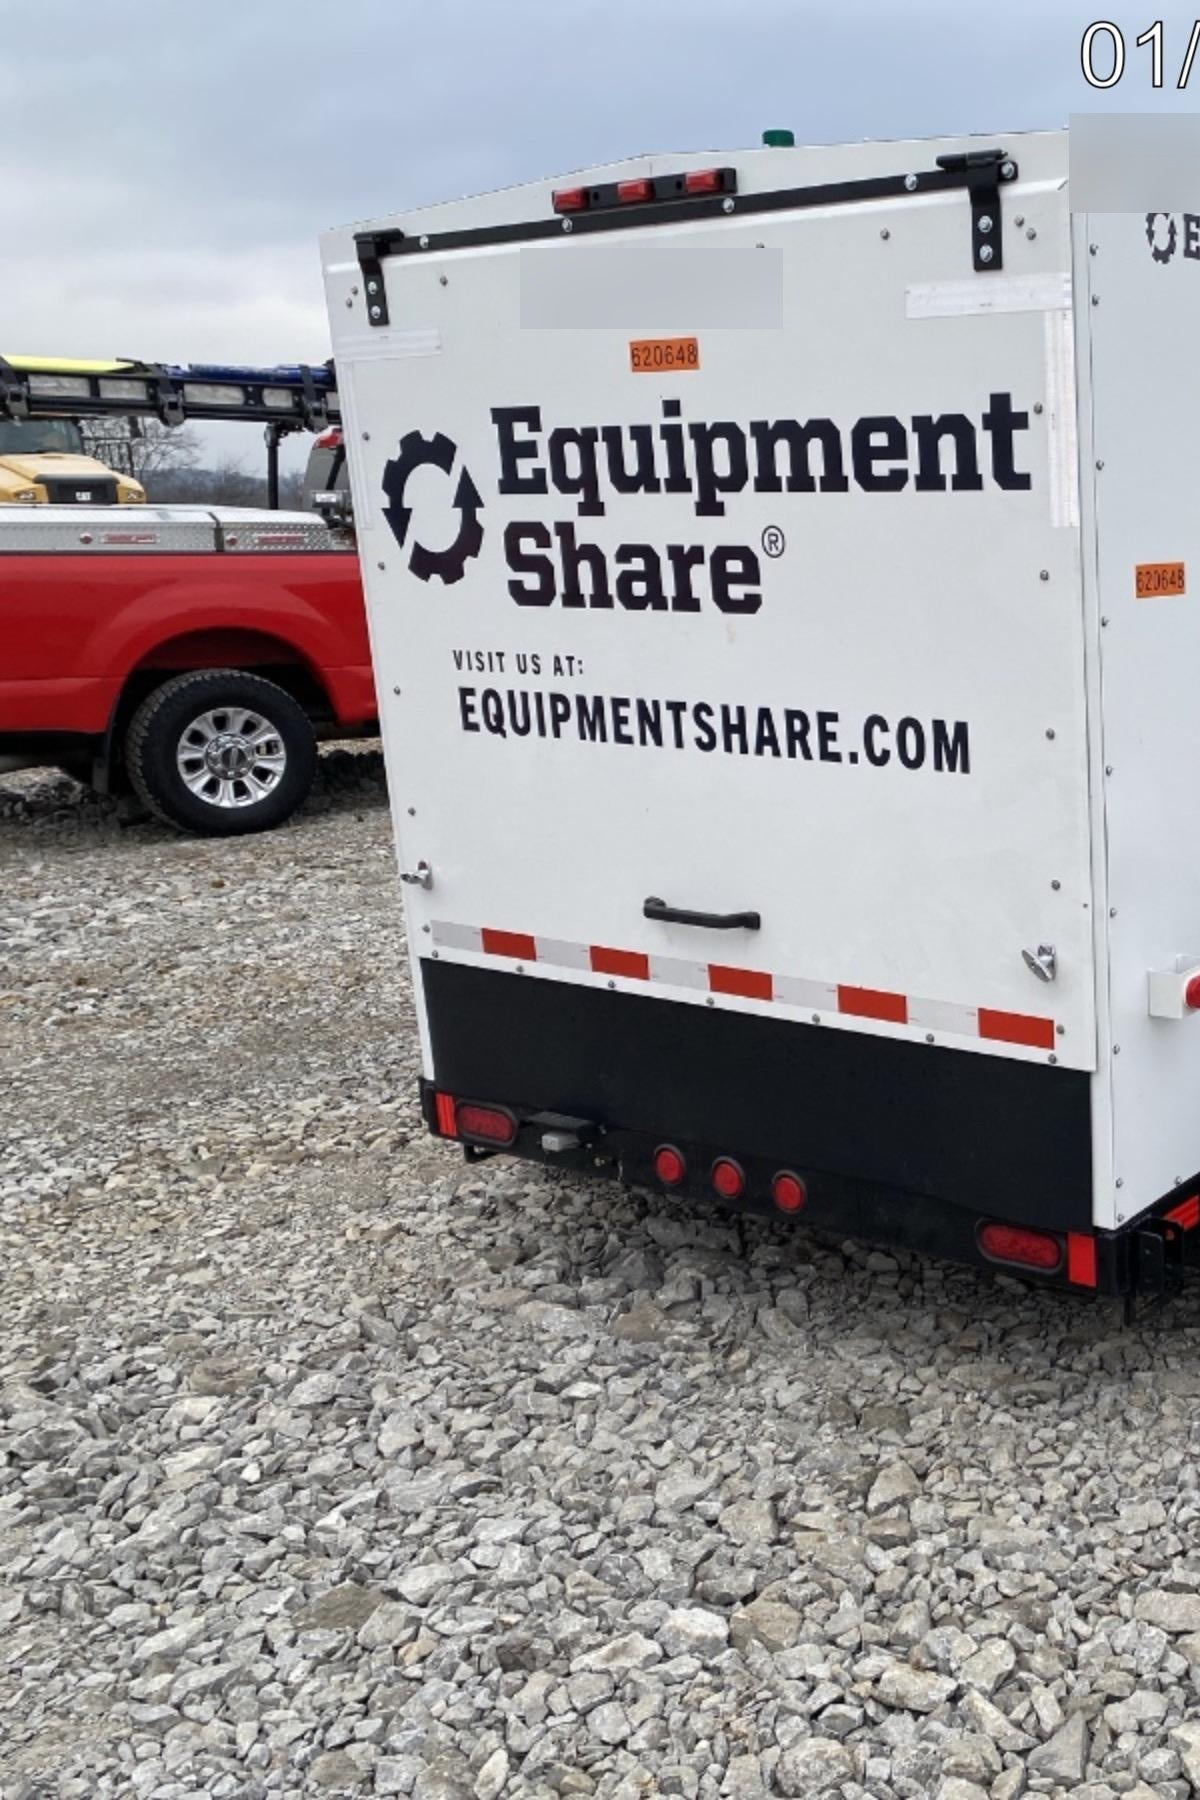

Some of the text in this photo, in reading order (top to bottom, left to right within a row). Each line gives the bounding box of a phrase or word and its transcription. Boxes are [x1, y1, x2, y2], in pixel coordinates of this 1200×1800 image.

[631, 344, 698, 368] 620648
[491, 392, 1032, 517] Equipment
[1136, 569, 1185, 593] 620648
[452, 649, 584, 677] VISIT US AT:
[458, 686, 971, 774] EQUIPMENTSHARE.COM
